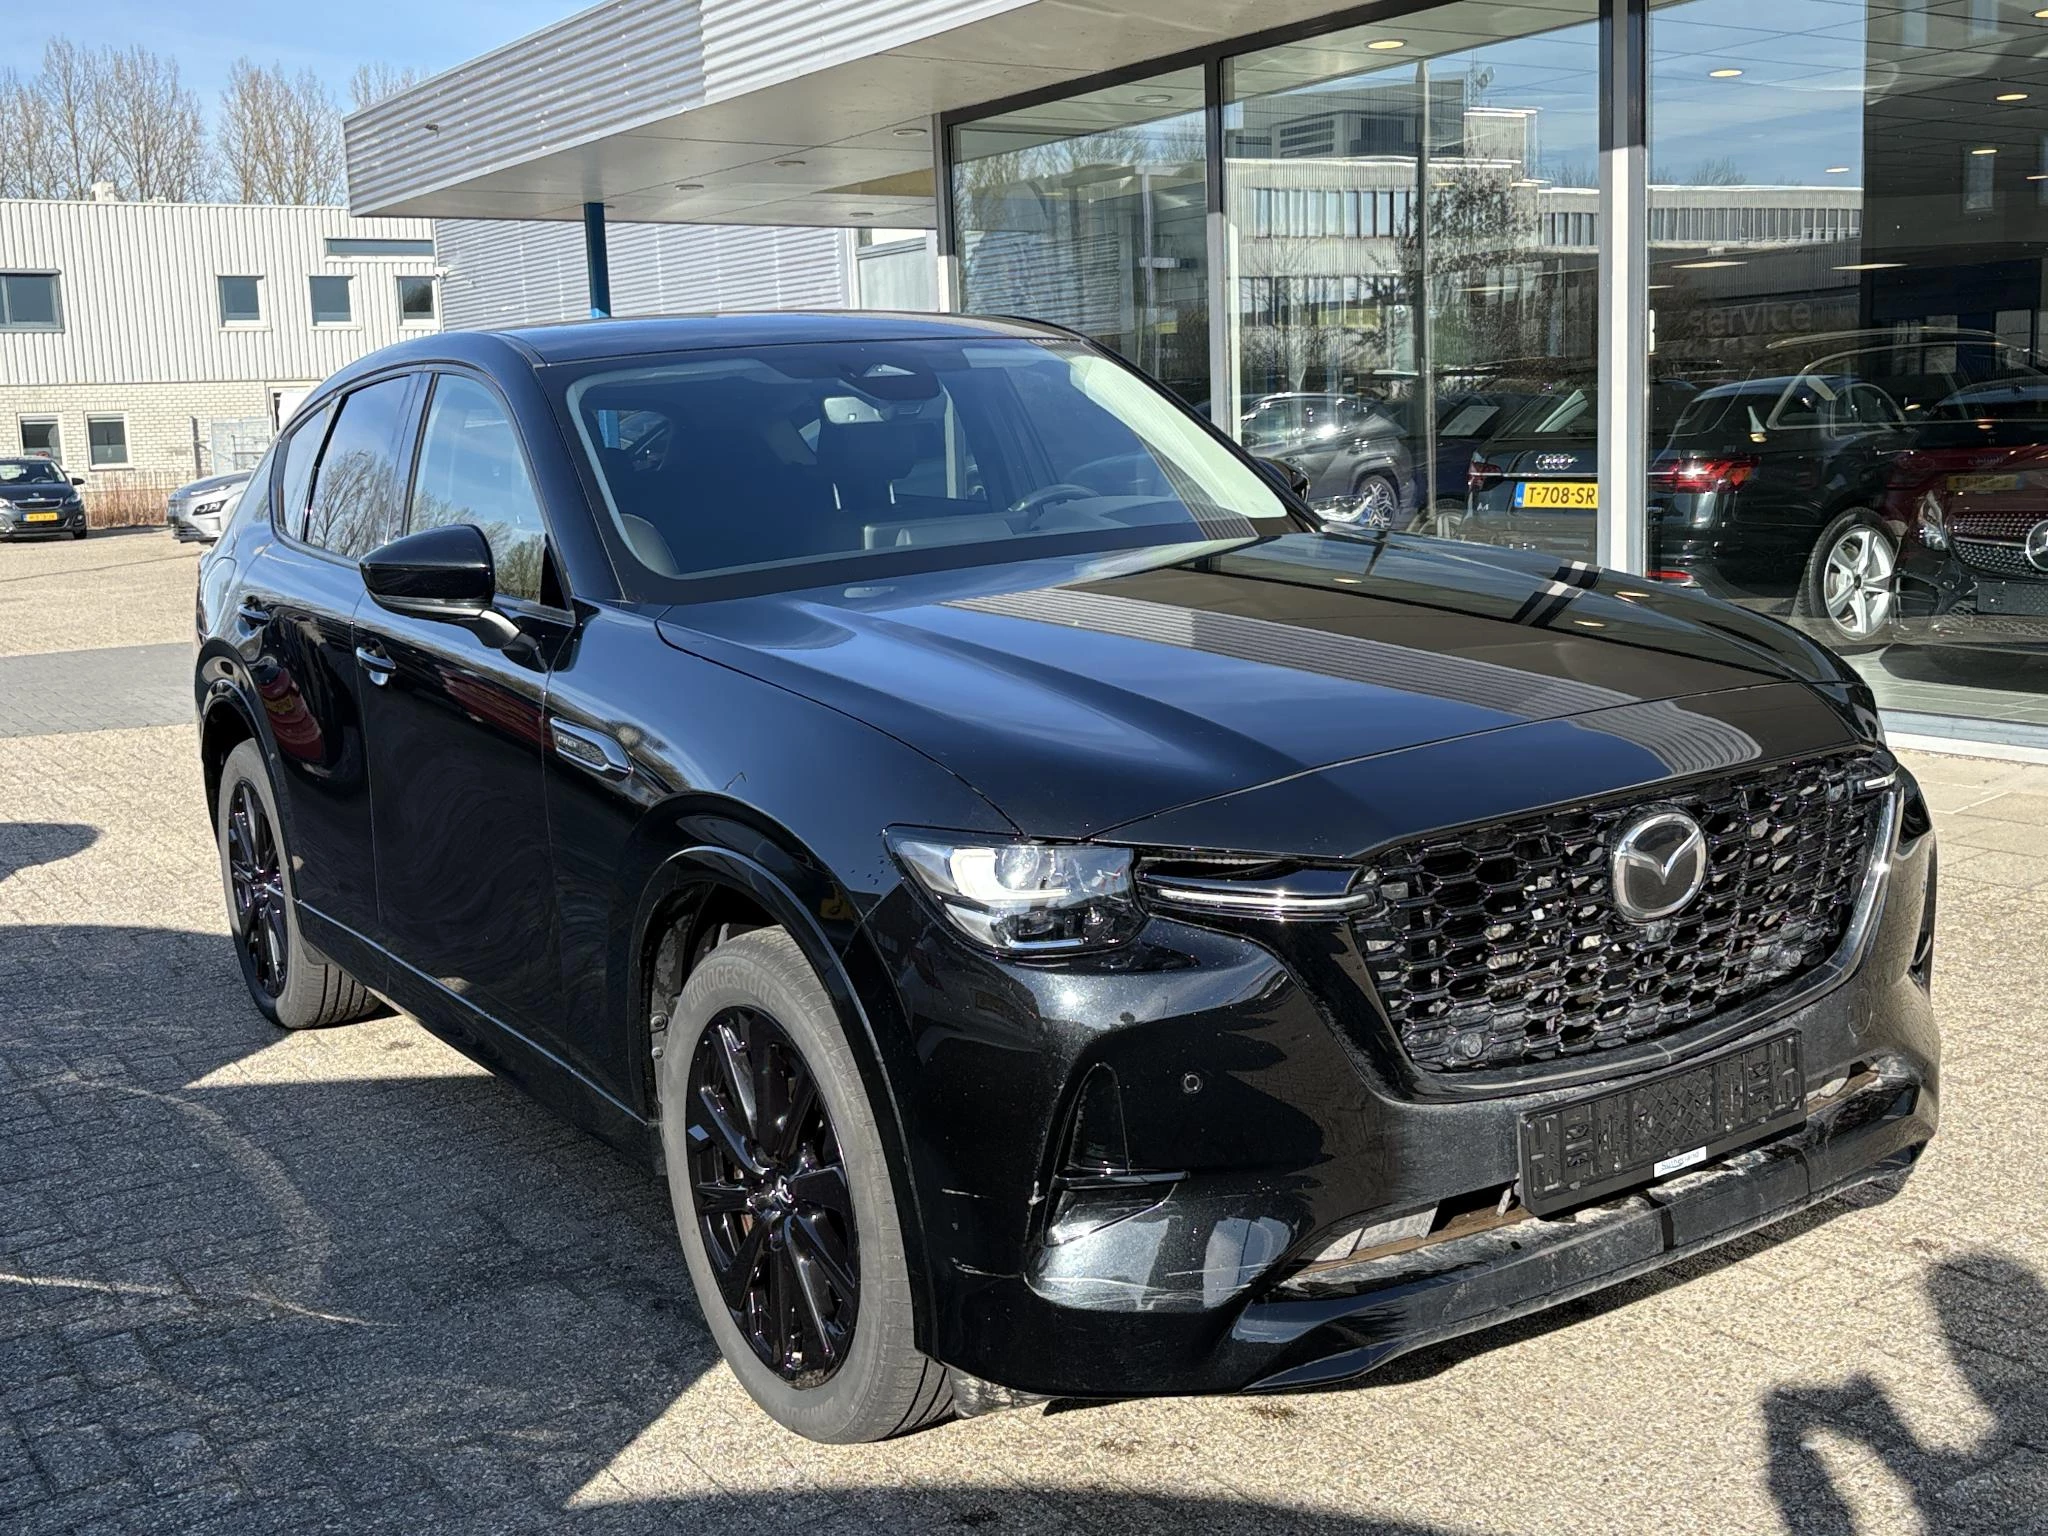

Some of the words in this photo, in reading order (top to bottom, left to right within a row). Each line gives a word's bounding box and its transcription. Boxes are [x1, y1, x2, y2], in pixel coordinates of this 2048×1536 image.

[1689, 303, 1811, 337] service
[1528, 486, 1596, 505] T-708-SR
[686, 964, 777, 1012] BRIDGESTONE
